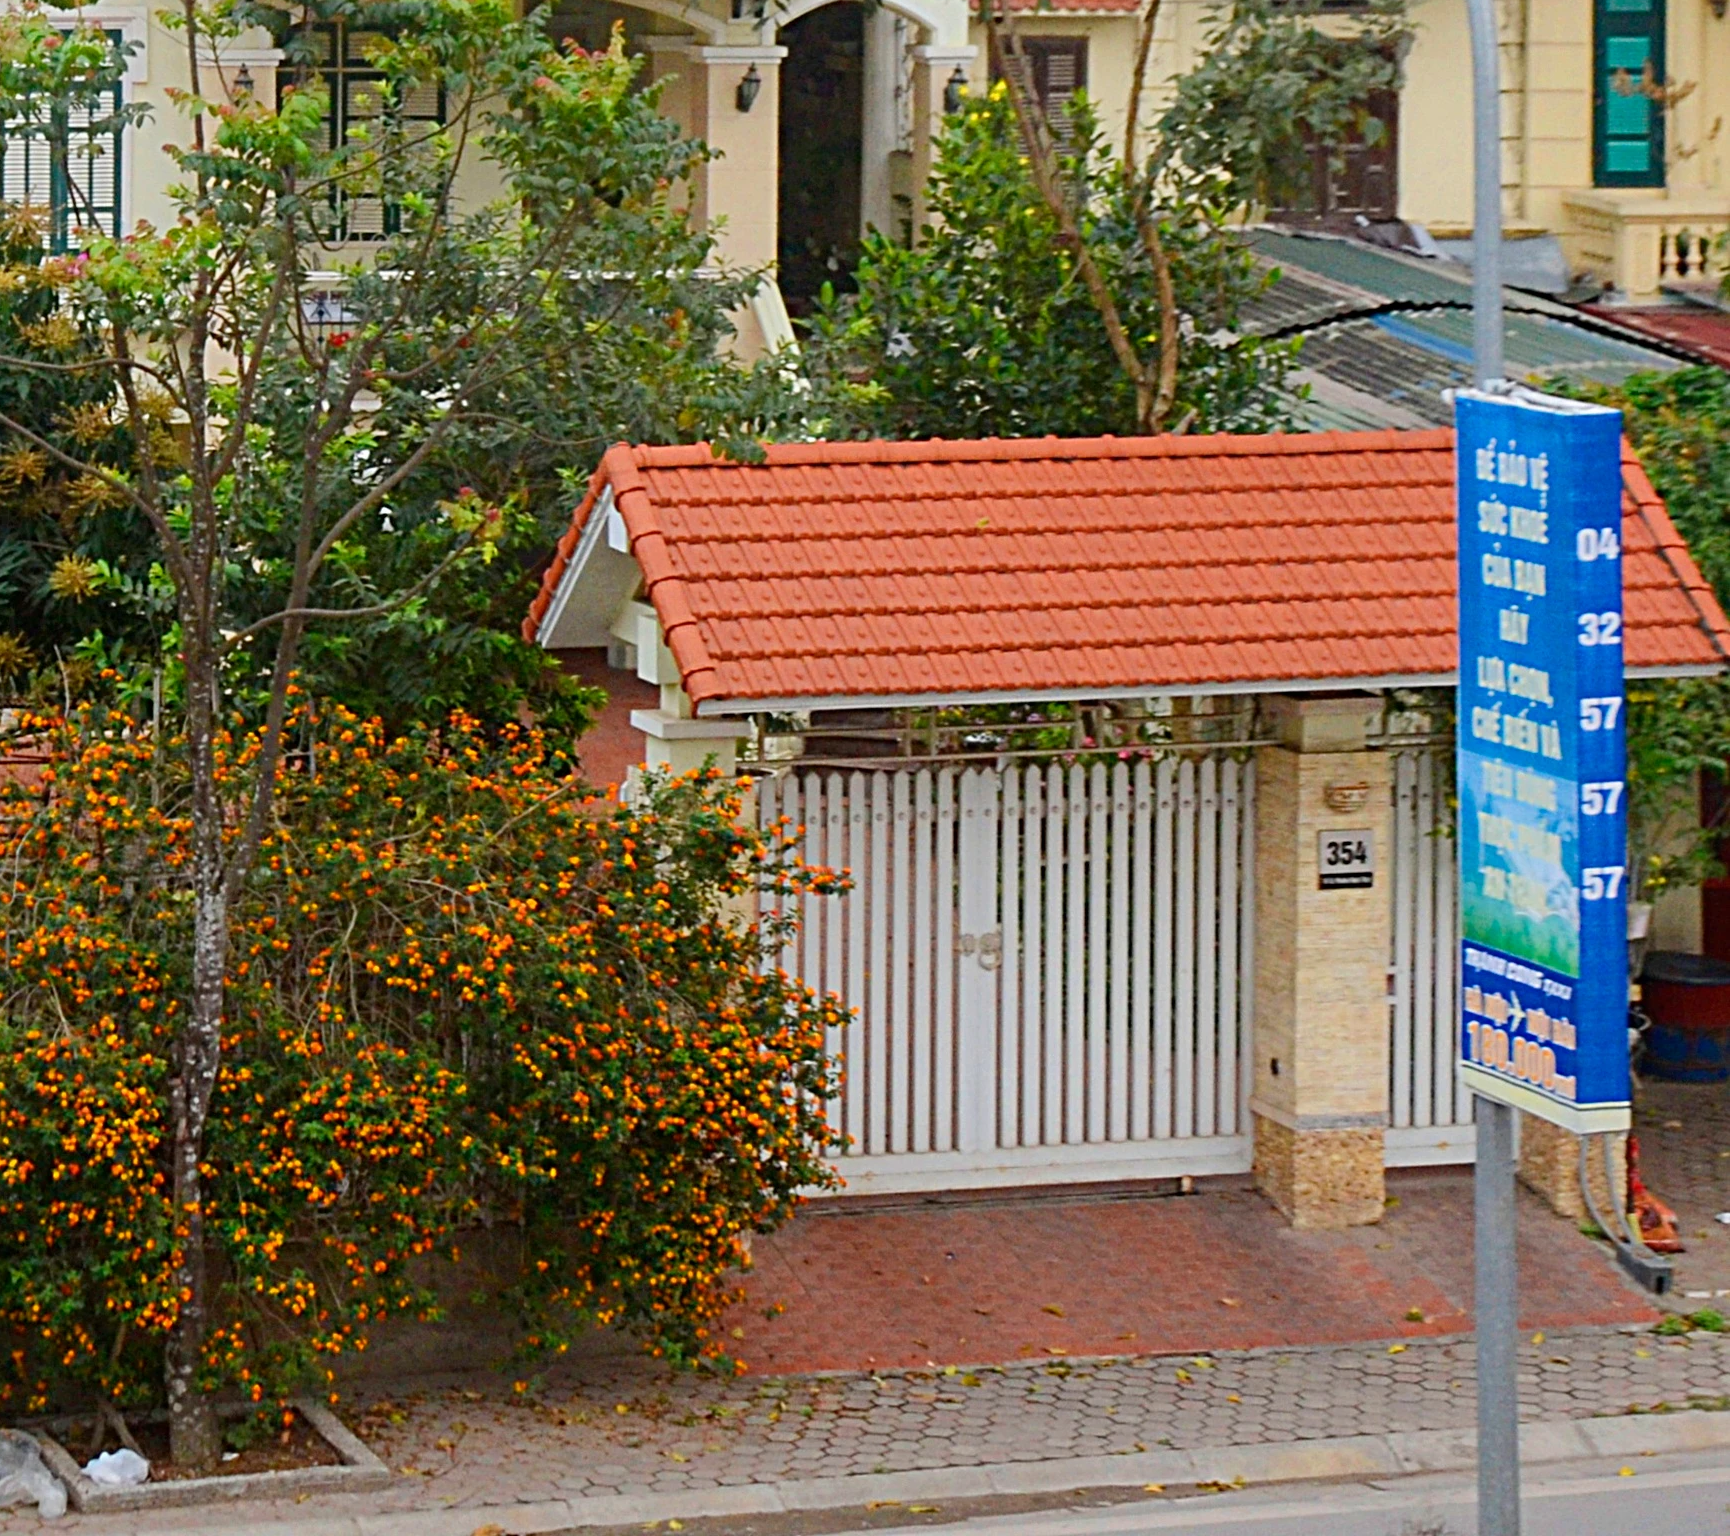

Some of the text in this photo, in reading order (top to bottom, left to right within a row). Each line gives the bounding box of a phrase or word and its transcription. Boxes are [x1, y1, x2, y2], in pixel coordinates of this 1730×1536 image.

[1576, 526, 1620, 562] 04
[1577, 611, 1621, 646] 32
[1579, 696, 1623, 732] 57
[1581, 780, 1624, 816] 57
[1326, 840, 1367, 866] 354
[1582, 865, 1625, 901] 57
